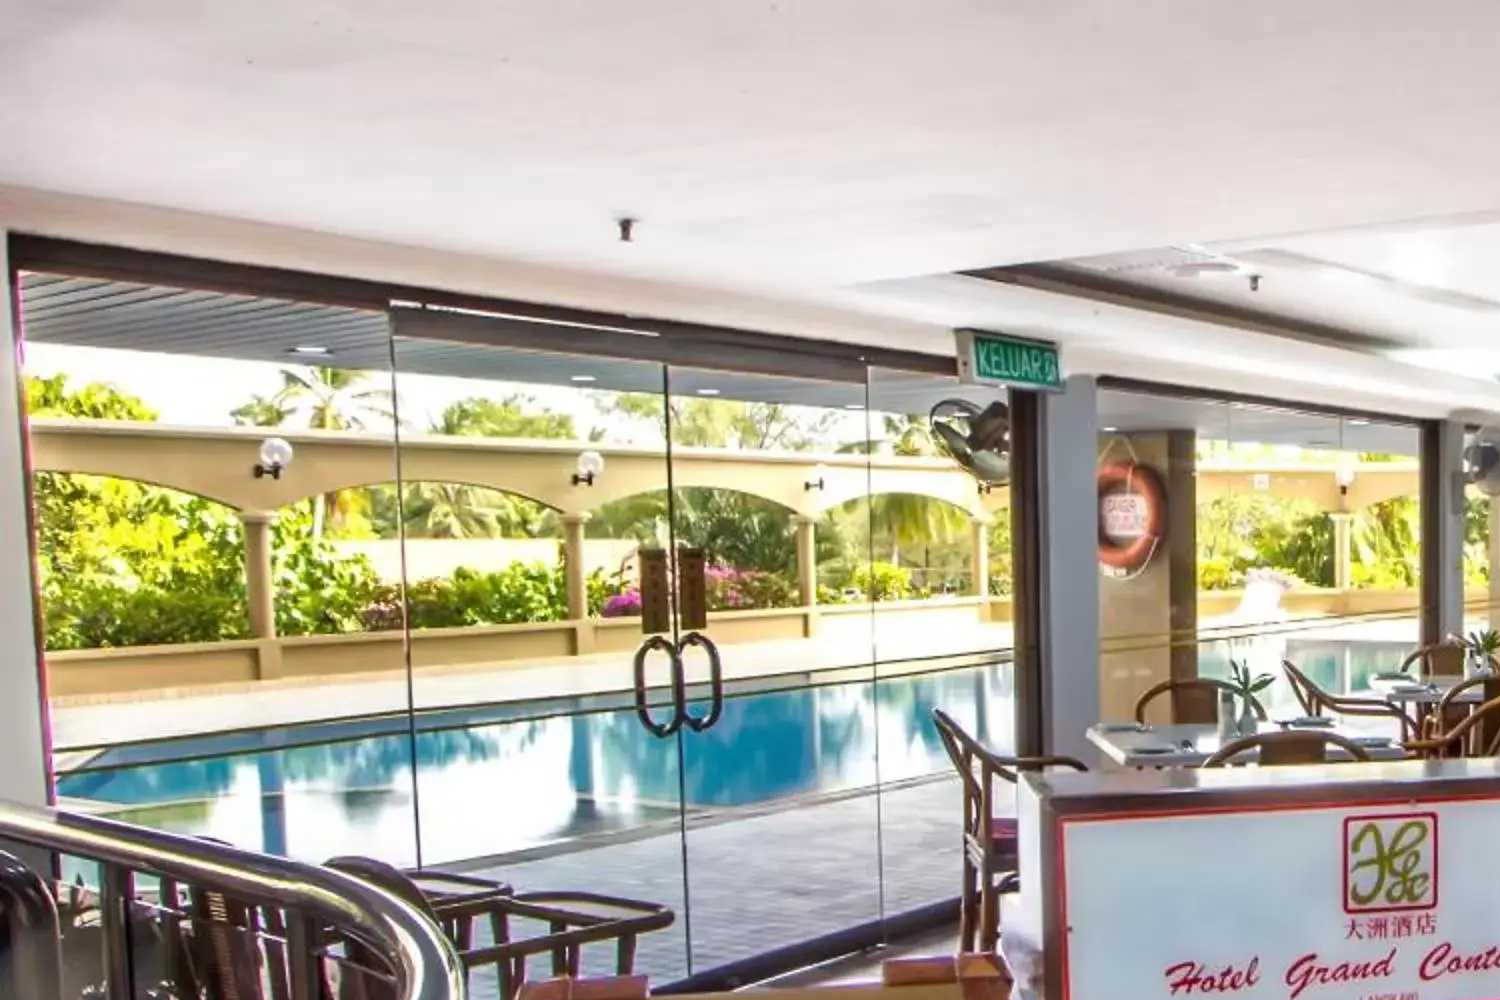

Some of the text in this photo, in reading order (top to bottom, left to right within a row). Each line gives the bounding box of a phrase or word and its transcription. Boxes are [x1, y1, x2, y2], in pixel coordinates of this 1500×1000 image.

[978, 341, 1041, 380] KELUAR
[1344, 912, 1437, 940] 大洲酒店
[1165, 956, 1259, 995] Hotel
[1285, 948, 1397, 1000] Grand
